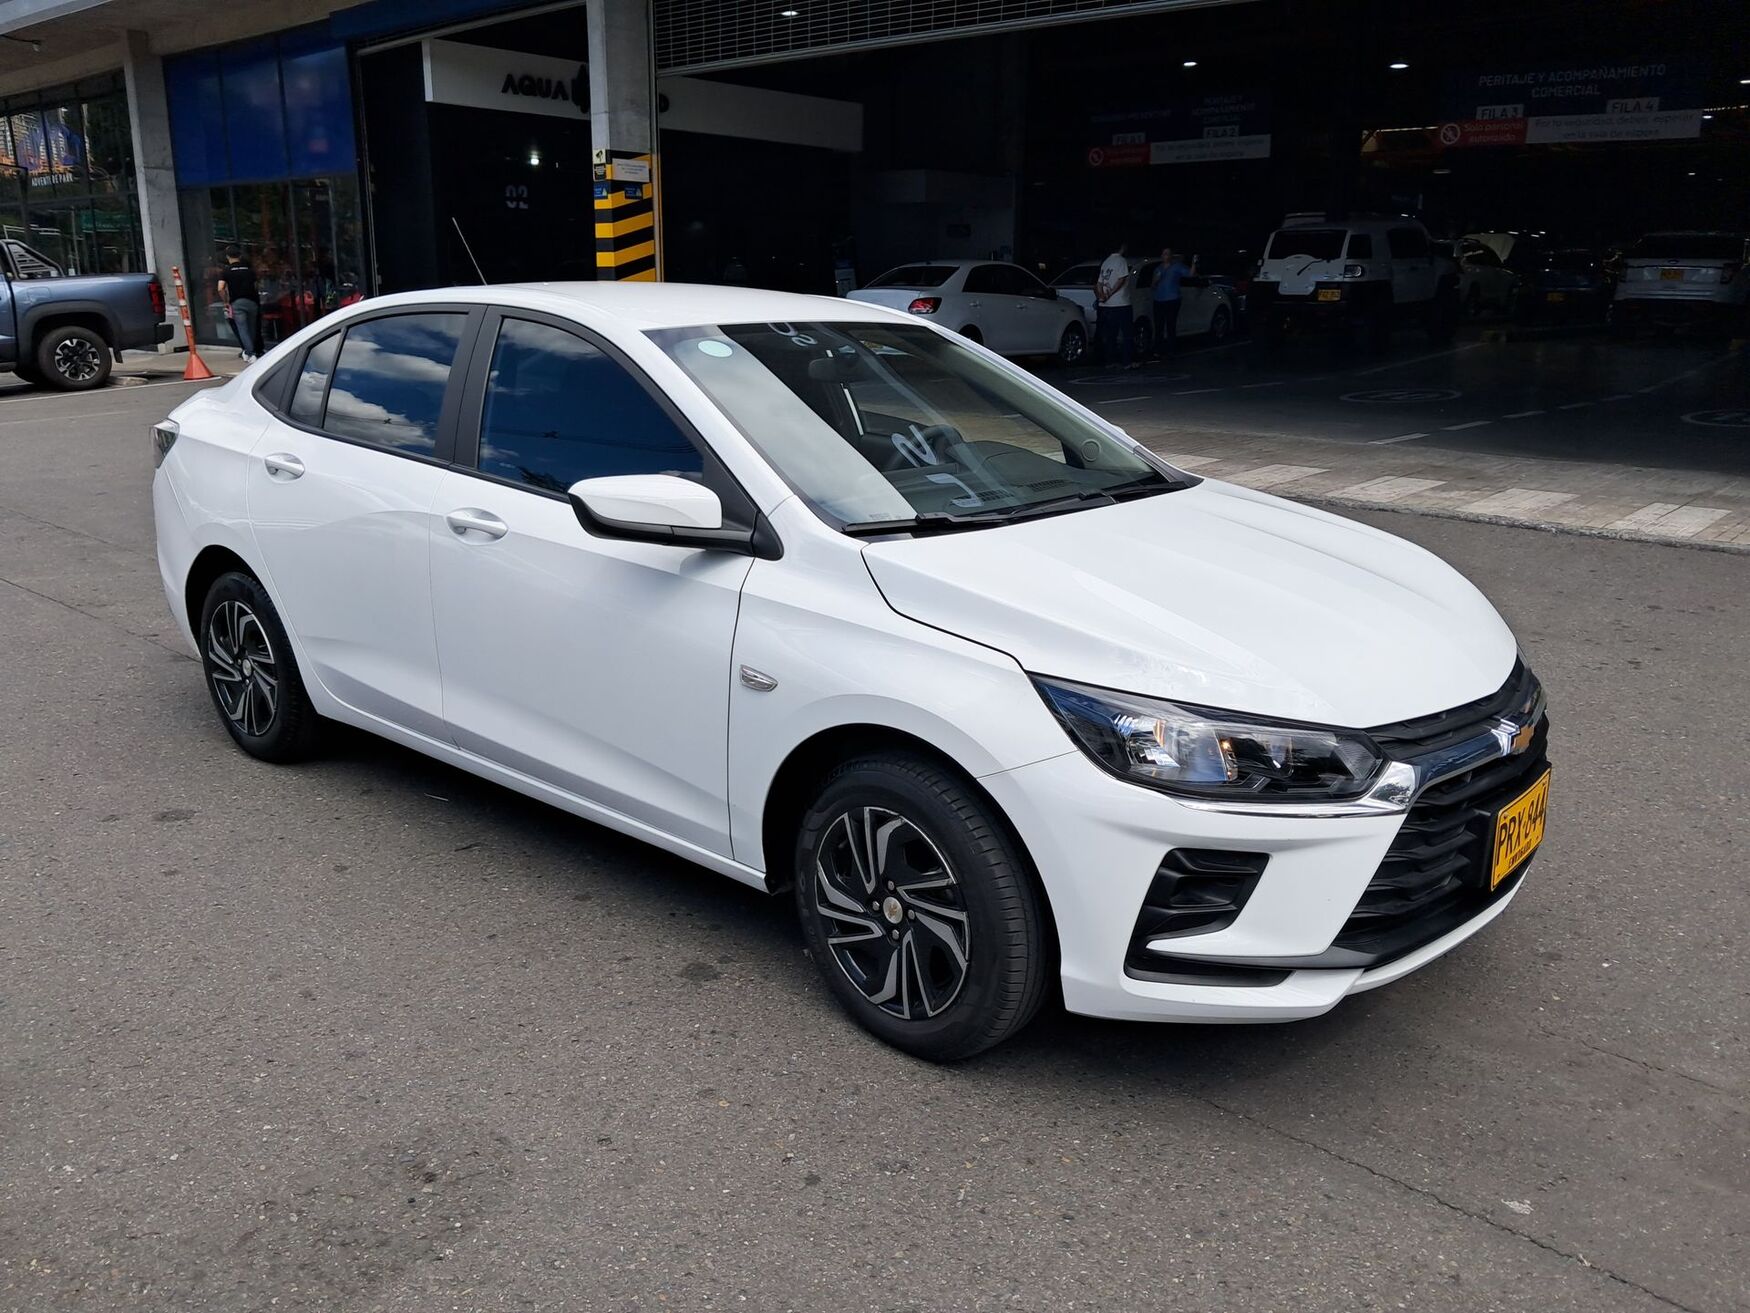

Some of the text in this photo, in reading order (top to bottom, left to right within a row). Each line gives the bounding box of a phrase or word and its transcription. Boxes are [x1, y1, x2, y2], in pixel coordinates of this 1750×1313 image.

[501, 73, 569, 101] AQUA
[1479, 63, 1666, 87] PERITAJE Y ACOMPAÑAMIENTO
[1531, 84, 1601, 98] COMERCIAL
[1613, 101, 1641, 113] FILA
[504, 184, 529, 210] 02
